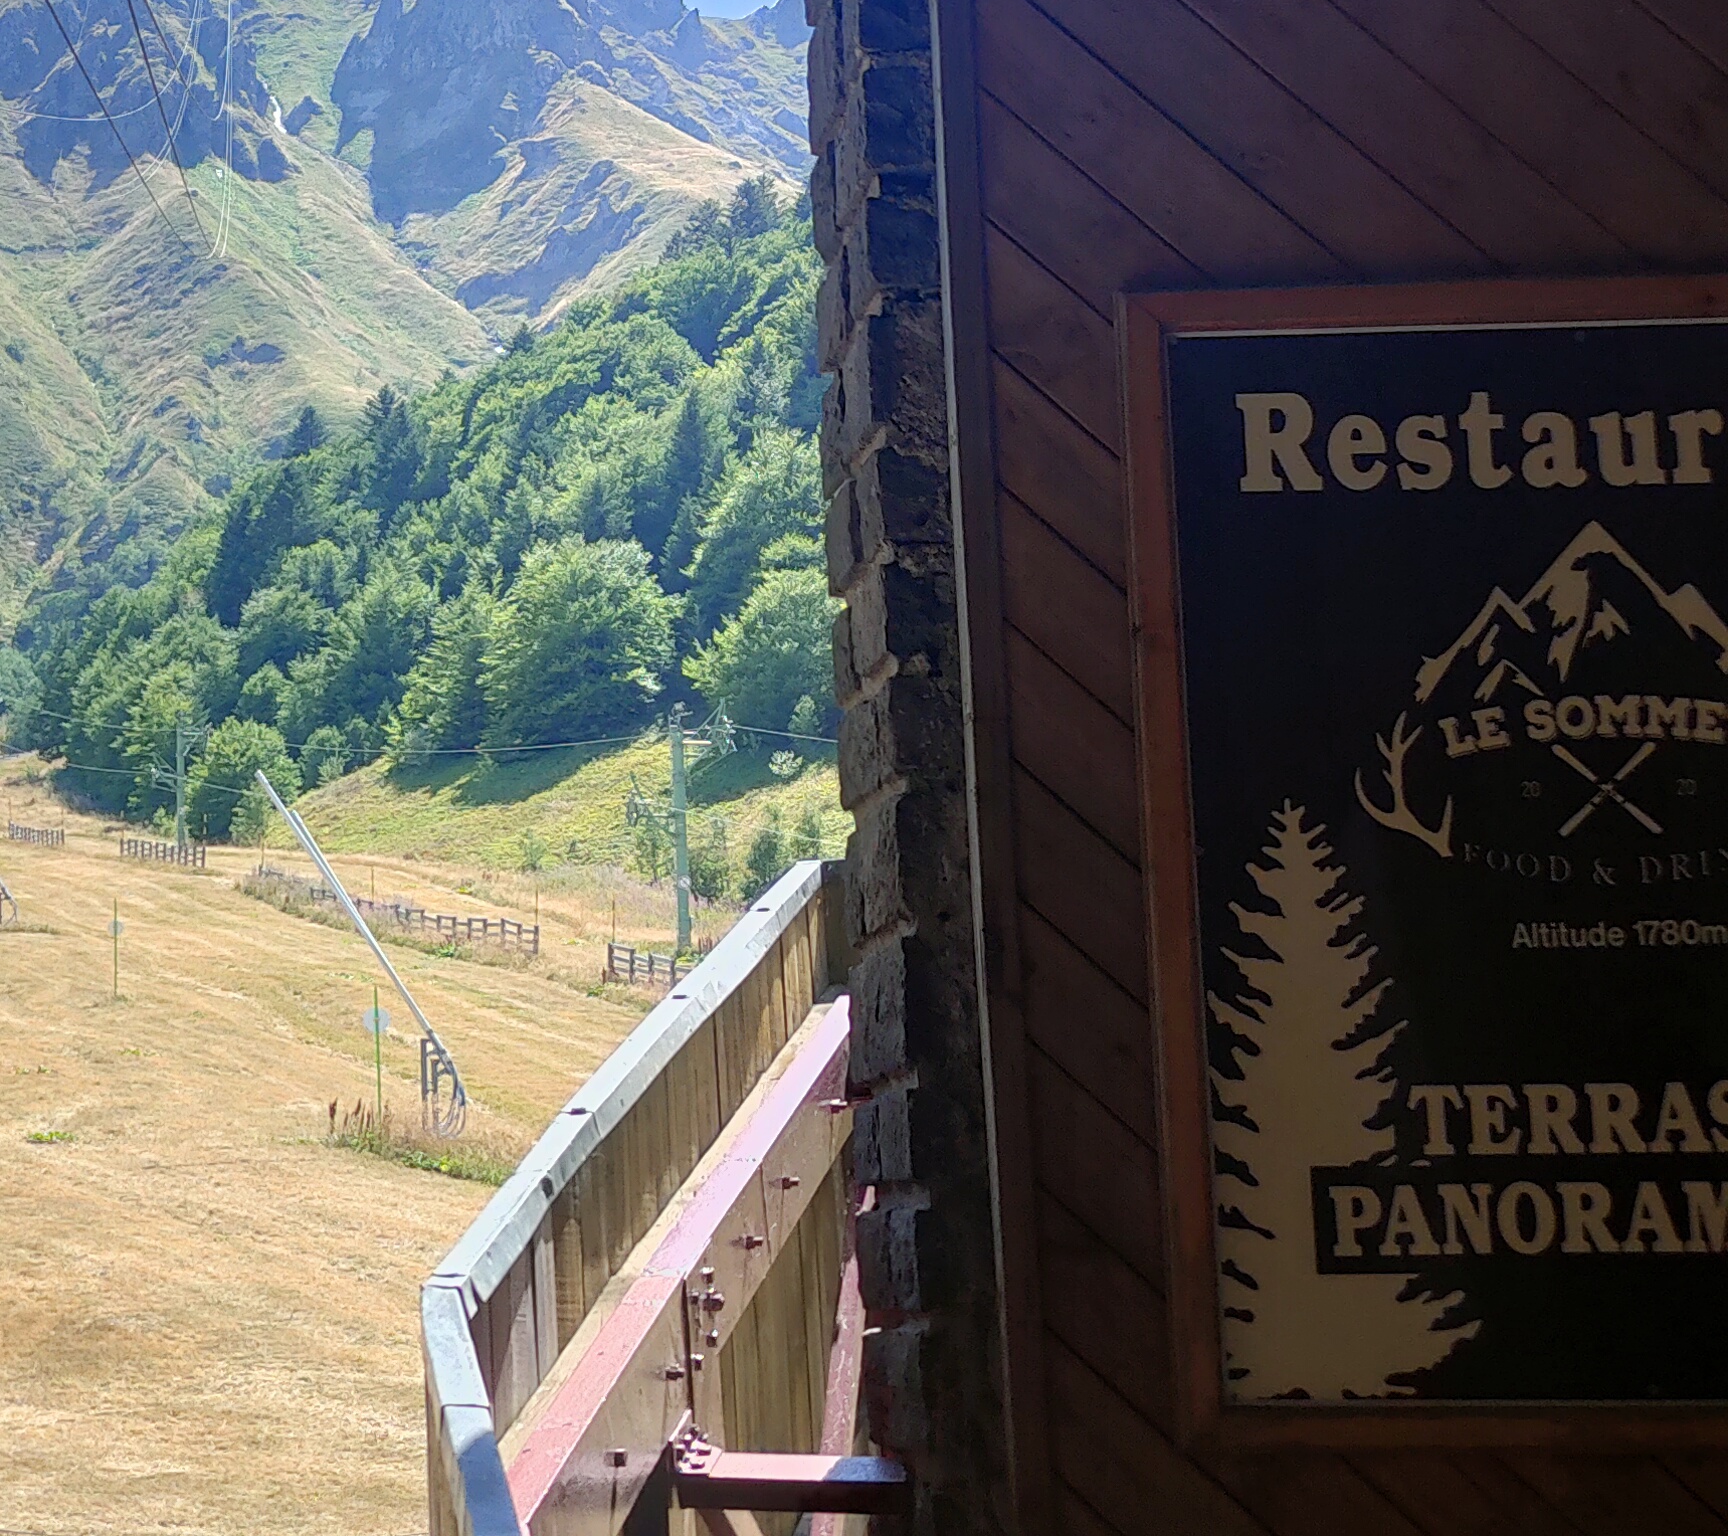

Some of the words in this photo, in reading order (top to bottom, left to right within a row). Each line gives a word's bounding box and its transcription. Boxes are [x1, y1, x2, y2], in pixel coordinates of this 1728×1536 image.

[1234, 391, 1724, 493] Restaur
[1436, 705, 1511, 758] LE
[1523, 694, 1728, 745] SOMME
[1521, 780, 1543, 799] 20
[1463, 842, 1571, 883] FOOD
[1591, 856, 1617, 886] &
[1512, 920, 1626, 949] Altitude
[1631, 919, 1728, 947] 1780m
[1328, 1180, 1728, 1258] PANORAM
